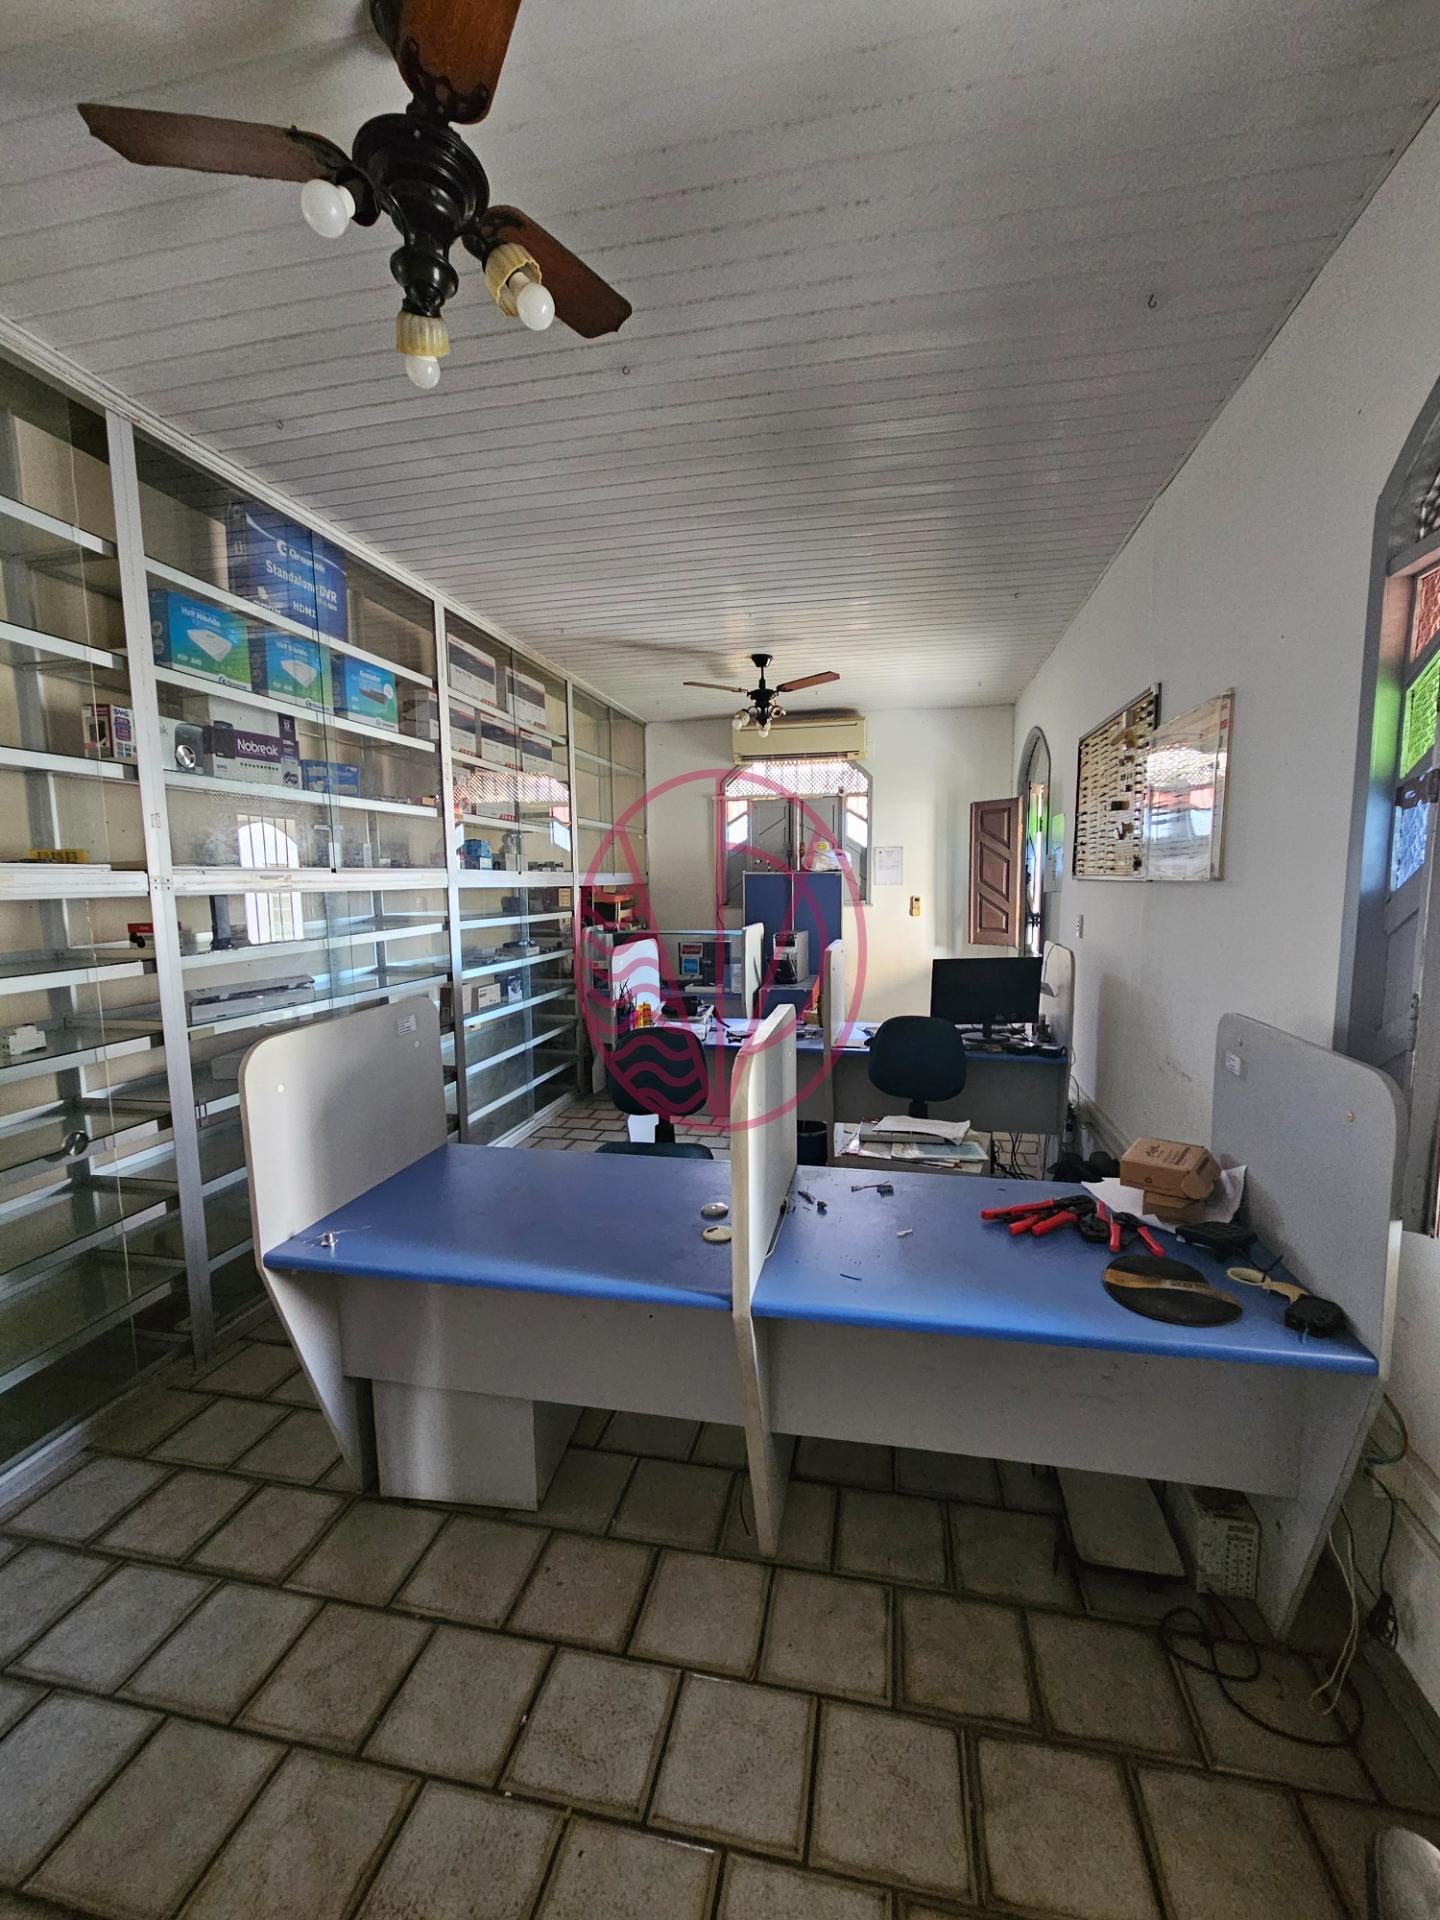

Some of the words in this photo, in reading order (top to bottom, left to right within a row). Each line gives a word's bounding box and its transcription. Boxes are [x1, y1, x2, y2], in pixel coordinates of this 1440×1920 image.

[320, 583, 337, 604] DVR
[293, 601, 316, 618] HDMI
[237, 738, 279, 756] Nobreak
